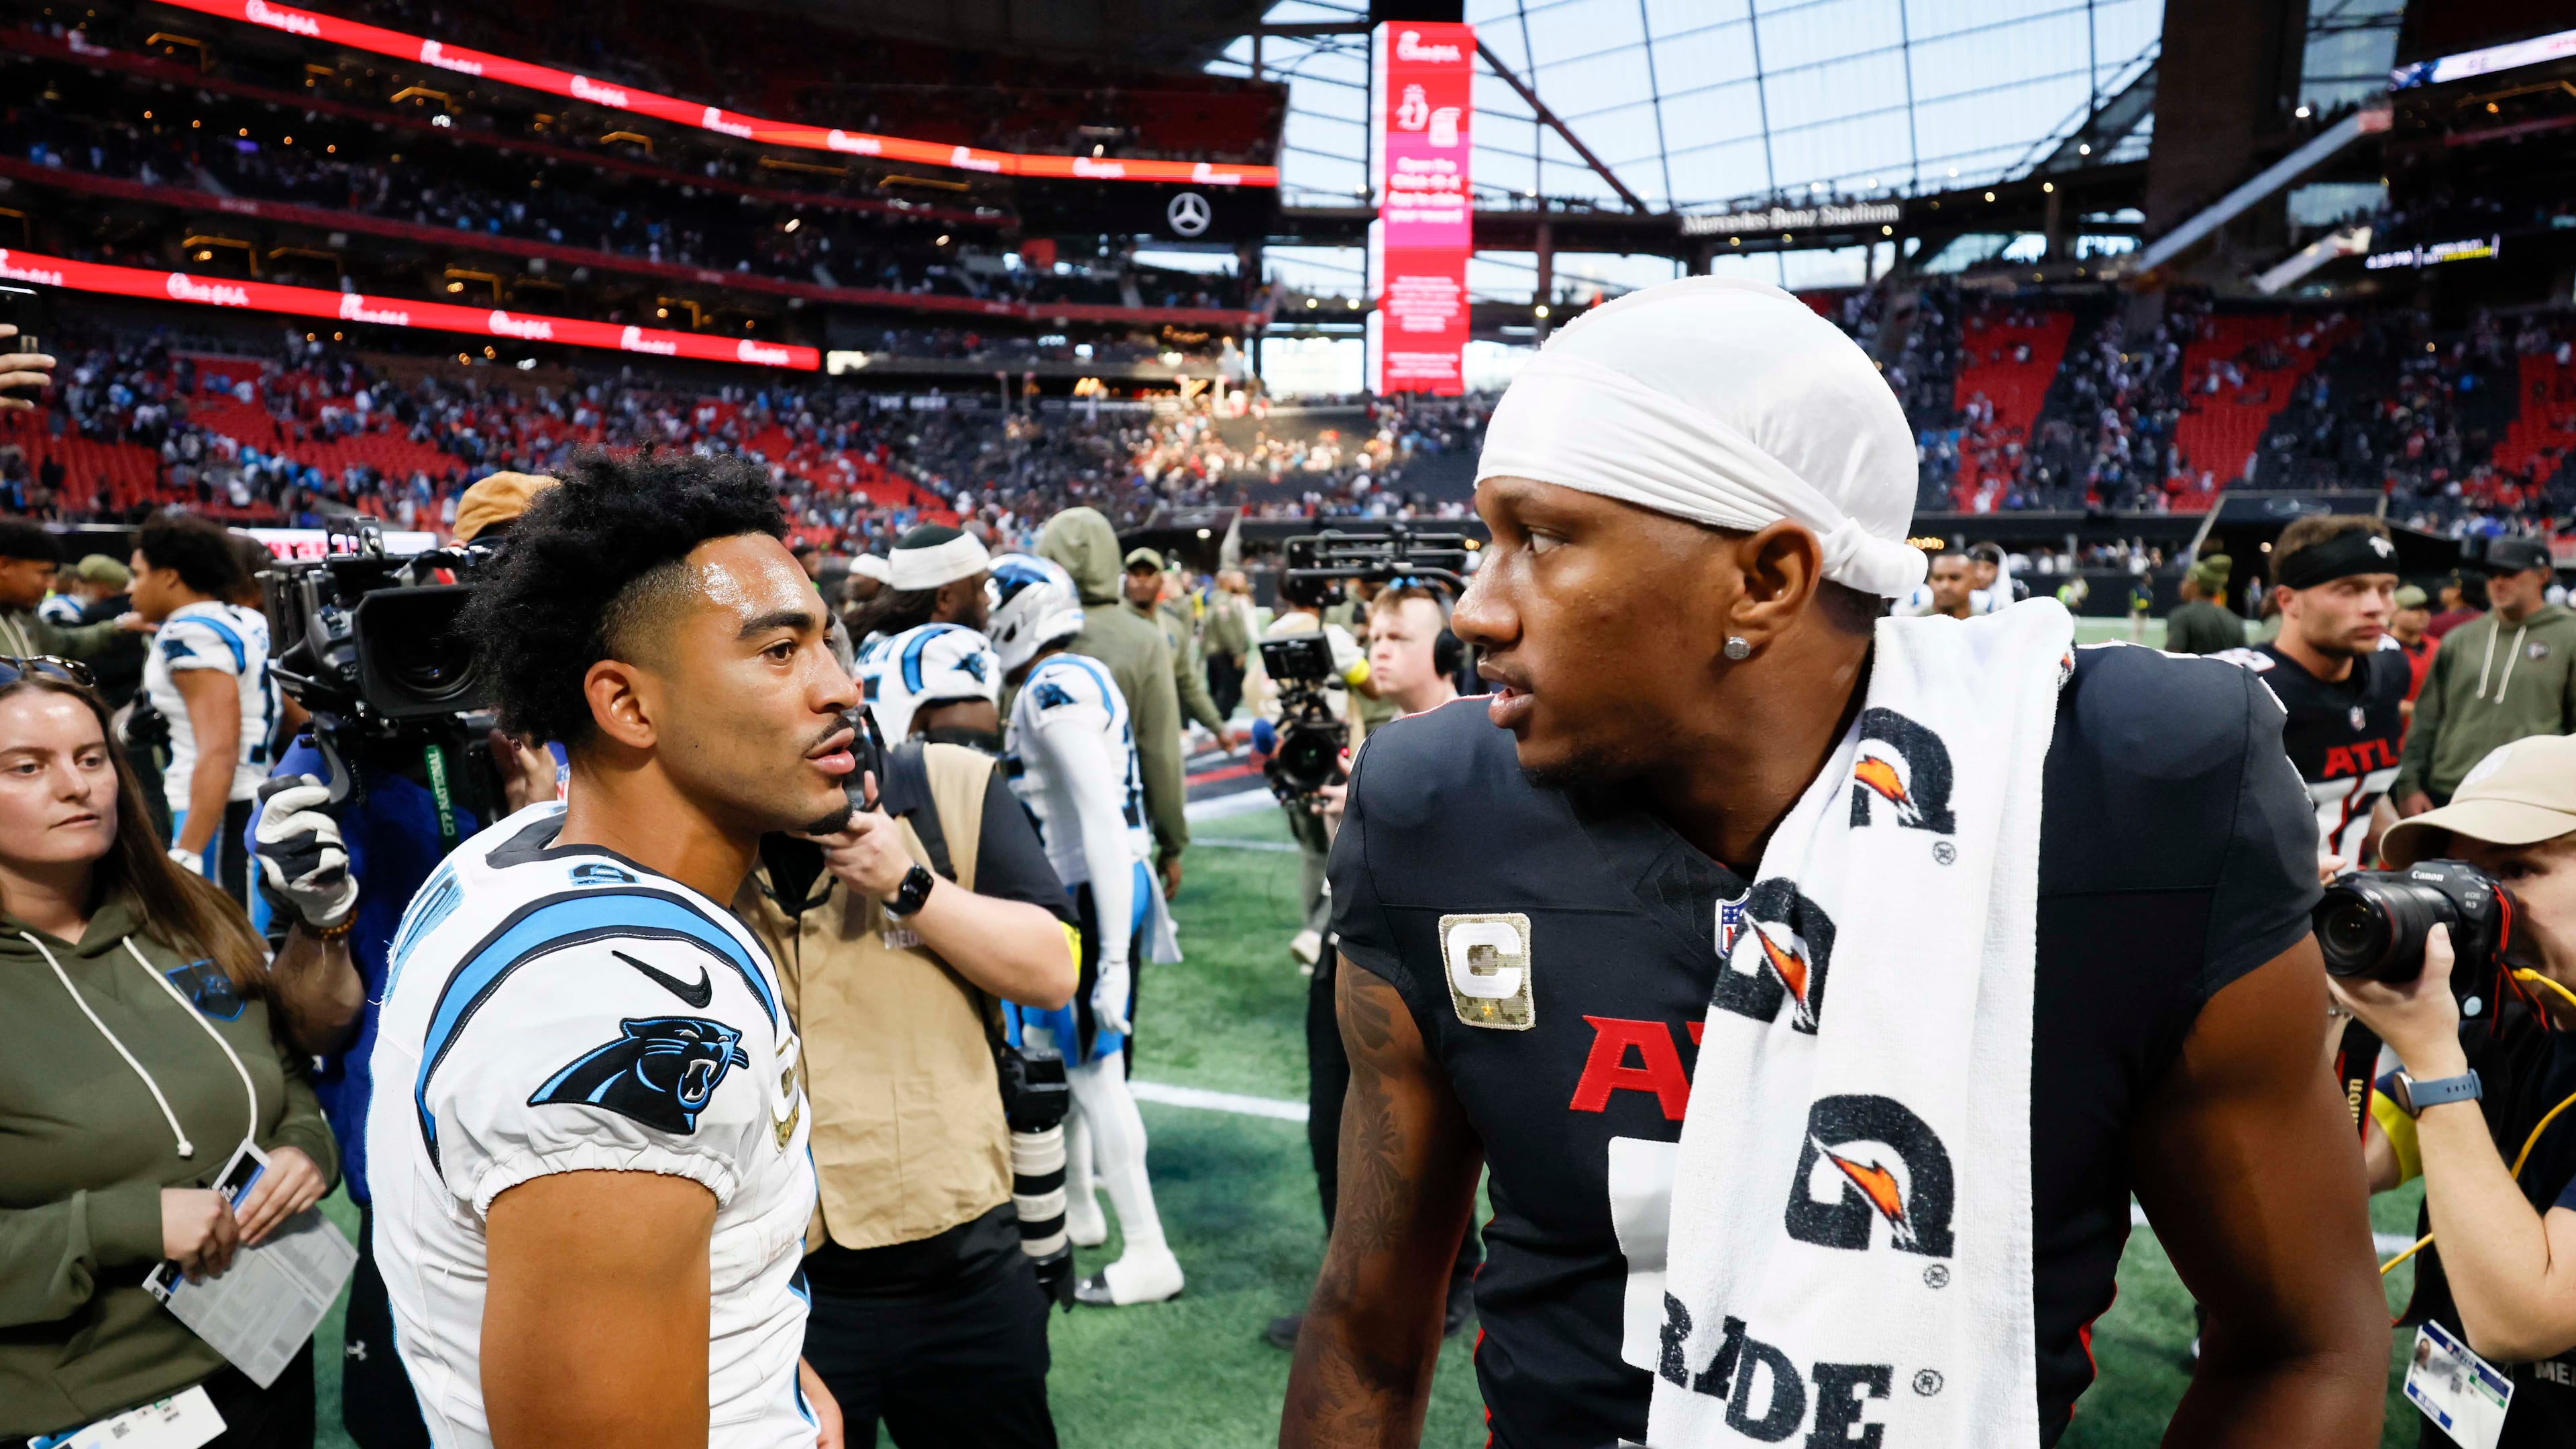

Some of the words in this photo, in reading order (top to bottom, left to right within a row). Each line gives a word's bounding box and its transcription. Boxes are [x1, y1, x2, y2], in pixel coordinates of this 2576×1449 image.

[1819, 203, 1899, 225] Stadium
[2323, 739, 2404, 778] ATL
[2411, 870, 2445, 882] Canon
[883, 930, 924, 950] MED
[1447, 922, 1521, 1000] C
[1569, 1014, 1707, 1121] A
[2348, 1078, 2364, 1124] non
